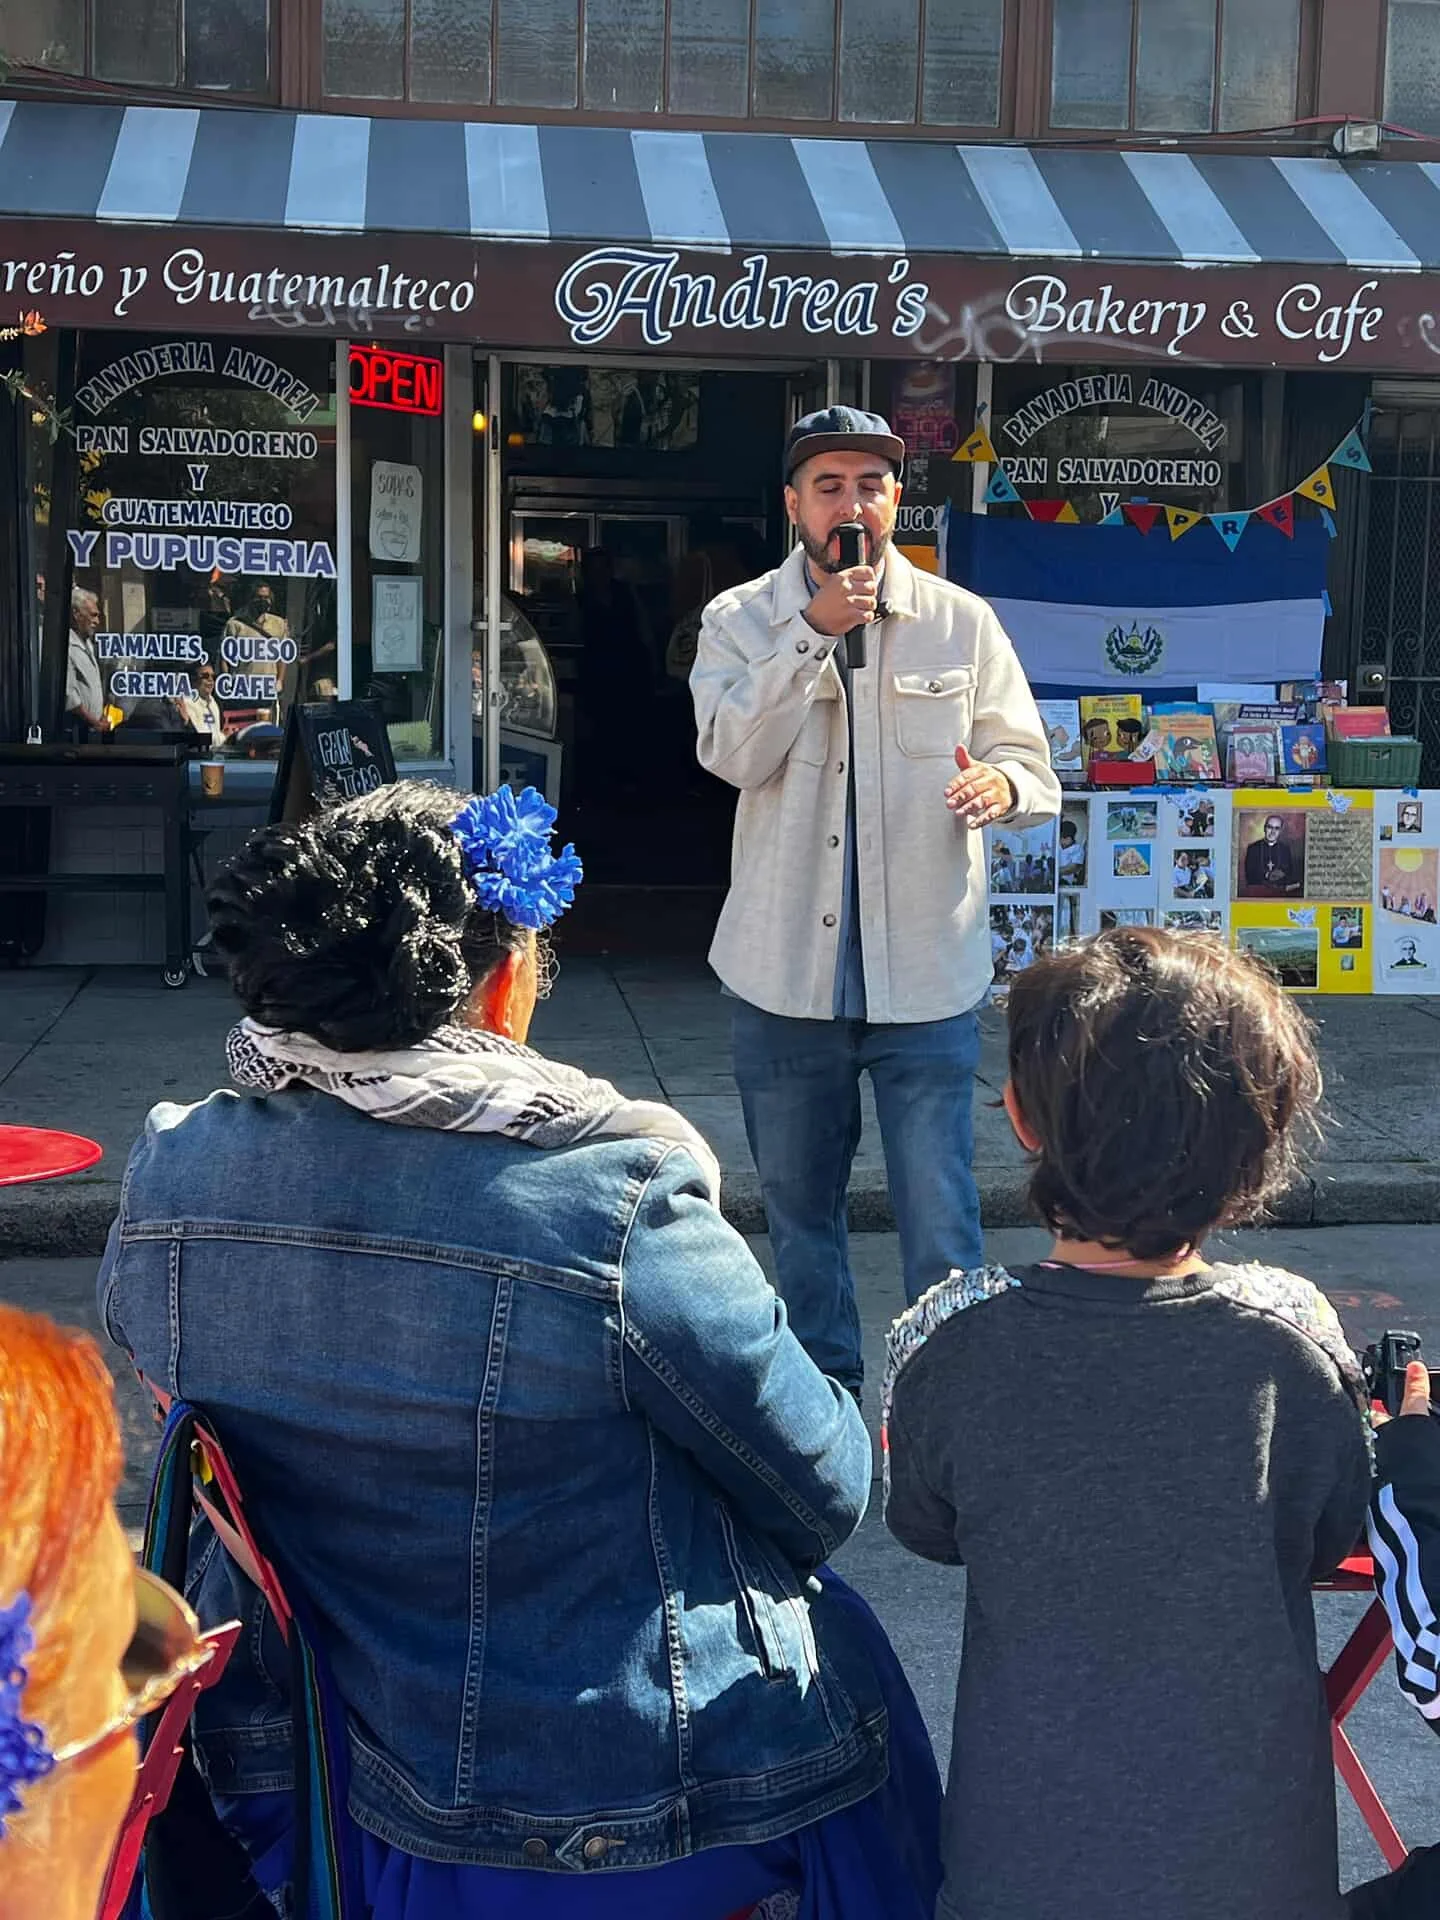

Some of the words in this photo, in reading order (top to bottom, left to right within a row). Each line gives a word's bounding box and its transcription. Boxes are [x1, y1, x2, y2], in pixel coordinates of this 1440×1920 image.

[2, 251, 104, 297] reño
[119, 263, 148, 317] y
[163, 248, 475, 313] Guatemalteco
[555, 246, 928, 345] Andrea's
[1004, 274, 1207, 355] Bakery
[1220, 300, 1259, 338] &
[1275, 280, 1384, 362] Cafe
[75, 342, 215, 416] PANADERIA
[222, 347, 320, 424] ANDREA
[348, 351, 437, 408] OPEN
[1002, 374, 1132, 447] PANADERIA
[1139, 378, 1227, 452] ANDREA
[76, 425, 128, 453] PAN
[139, 427, 318, 459] SALVADORENO
[186, 464, 209, 491] Y
[1000, 457, 1047, 484] PAN
[1057, 457, 1222, 486] SALVADORENO
[103, 498, 292, 530] GUATEMALTECO
[1099, 493, 1120, 517] Y
[66, 530, 101, 567] Y
[106, 532, 339, 578] PUPUSERIA
[95, 633, 208, 664] TAMALES,
[221, 636, 297, 666] QUESO
[215, 673, 278, 700] CAFE
